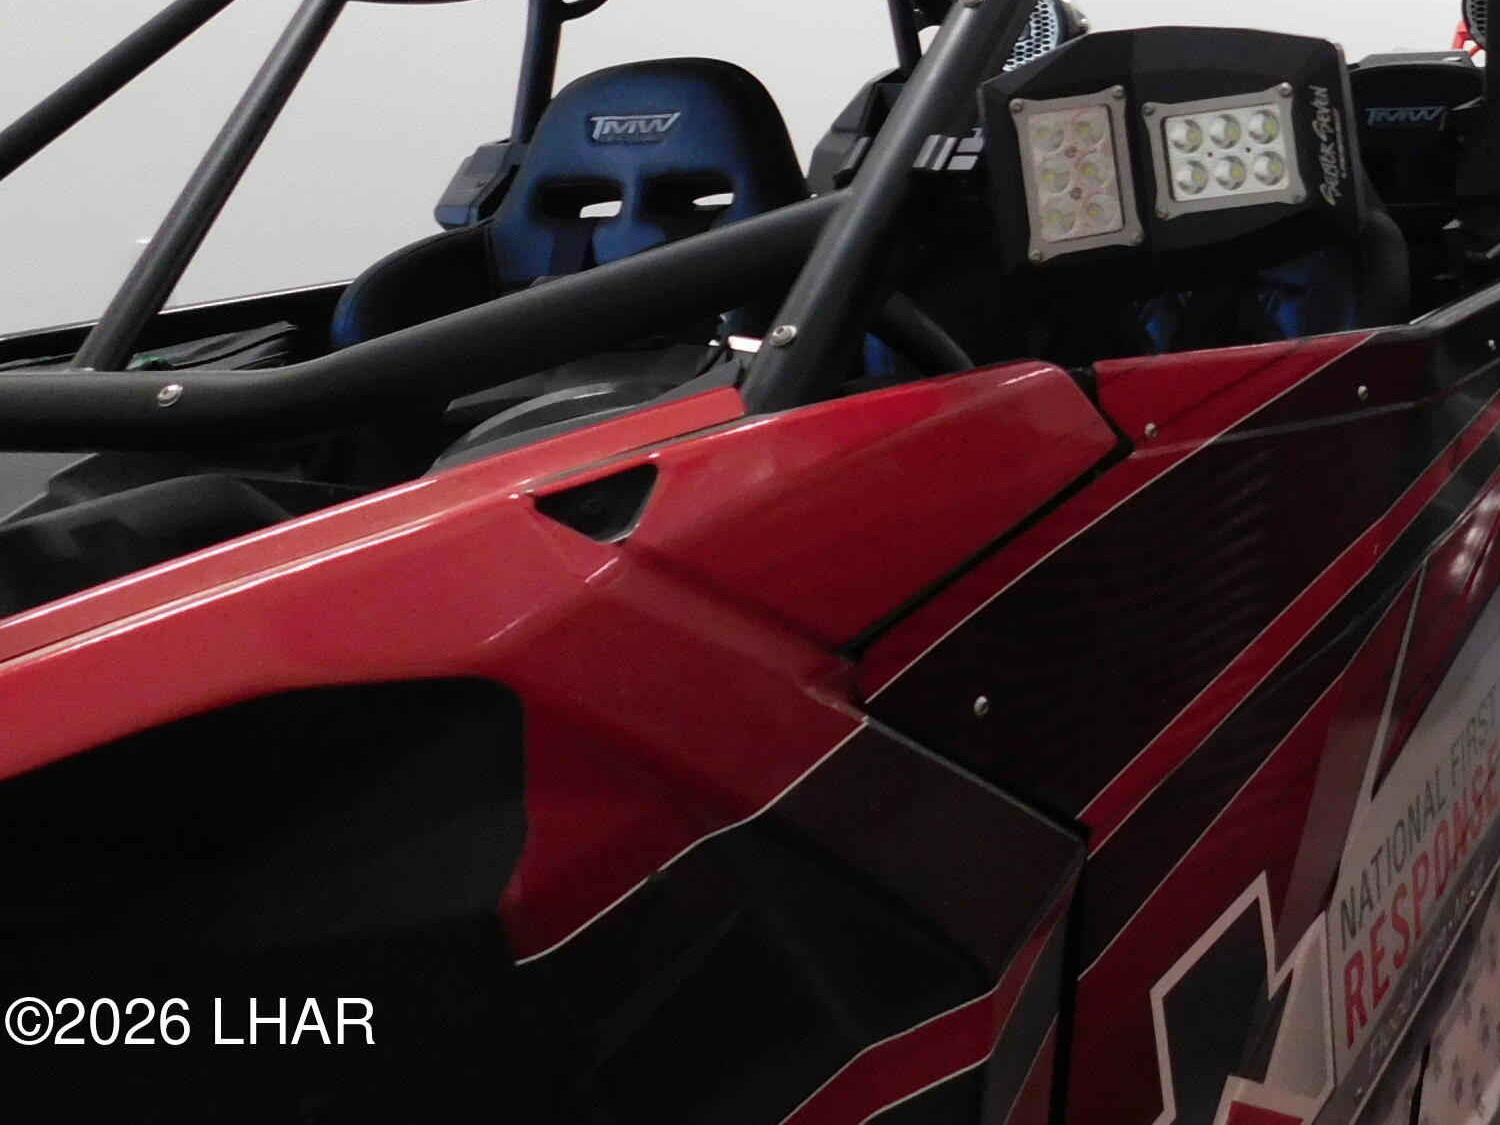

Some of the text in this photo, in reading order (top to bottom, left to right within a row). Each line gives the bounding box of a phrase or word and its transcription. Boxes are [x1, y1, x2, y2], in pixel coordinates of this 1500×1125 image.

[589, 111, 682, 140] TMW
[1366, 105, 1448, 126] TMW
[1339, 764, 1446, 952] NATIONAL
[1342, 738, 1500, 1049] RESPONSE
